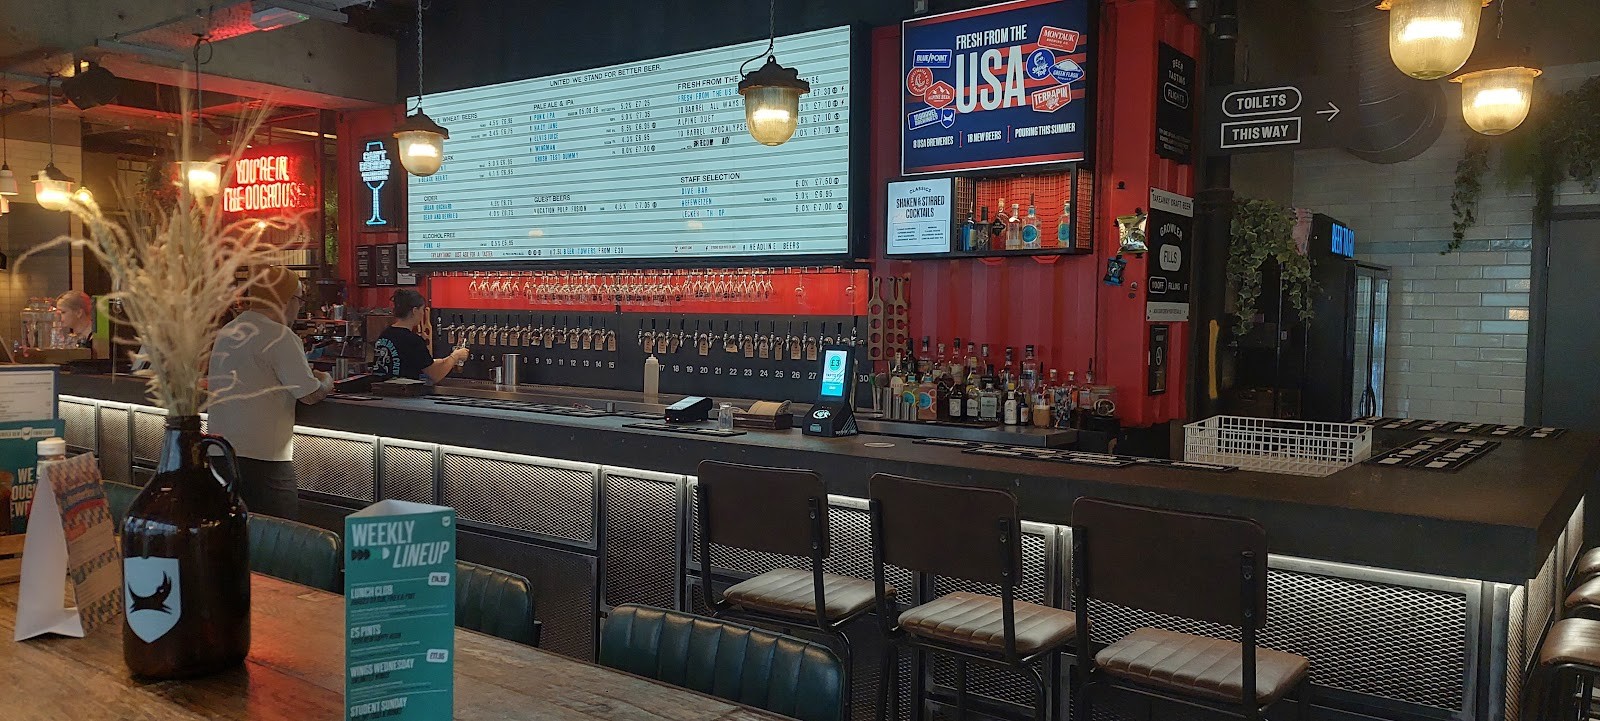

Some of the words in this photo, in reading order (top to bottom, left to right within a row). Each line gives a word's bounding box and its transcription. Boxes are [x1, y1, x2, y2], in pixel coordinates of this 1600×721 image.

[956, 32, 983, 50] FRESH
[984, 28, 1009, 44] FROM
[1010, 24, 1027, 40] THE
[584, 73, 602, 81] STAND
[618, 67, 642, 76] BETTER
[956, 46, 1026, 113] USA
[1168, 70, 1186, 86] TASTING
[677, 81, 700, 90] FRESH
[702, 78, 722, 86] FROM
[725, 76, 739, 84] THE
[678, 92, 692, 102] FRESH
[696, 90, 710, 99] FROM
[813, 88, 831, 96] £7.30
[1034, 87, 1068, 105] TERRAPIN
[1167, 89, 1185, 103] FLIGHTS
[685, 105, 704, 113] BARREL
[710, 102, 719, 110] ALL
[813, 101, 831, 109] £7.10
[1236, 94, 1287, 110] TOILETS
[677, 117, 697, 126] ALPINE
[813, 113, 831, 123] £7.10
[686, 128, 705, 136] BARREL
[711, 124, 746, 134] APOCALYPSE
[973, 133, 985, 142] NEW
[985, 131, 1001, 141] BEERS
[1015, 127, 1038, 138] POURING
[1038, 126, 1051, 135] THIS
[1051, 123, 1075, 134] SUMMER
[1232, 128, 1260, 141] THIS
[1261, 124, 1289, 139] WAY
[917, 139, 926, 148] USA
[927, 136, 954, 147] BREWERIES
[550, 153, 561, 161] TEST
[236, 156, 275, 184] YOU'RE
[276, 156, 289, 181] IN
[680, 174, 700, 183] STAFF
[702, 172, 740, 182] SELECTION
[681, 187, 694, 195] DIVE
[224, 187, 245, 212] THE
[681, 198, 712, 207] HEFEWEIZEN
[896, 197, 917, 208] SHAKEN
[922, 196, 944, 206] STIRRED
[1152, 193, 1169, 205] TAKEAWAY
[1171, 198, 1181, 208] DRAFT
[1182, 201, 1191, 210] BEER
[906, 208, 934, 218] COCKTAILS
[1159, 223, 1183, 241] GROWLER
[749, 242, 777, 250] HEADLINE
[783, 242, 800, 250] BEERS
[1163, 251, 1178, 264] FILLS
[686, 365, 693, 373] 19
[715, 367, 722, 375] 21
[729, 368, 737, 376] 22
[744, 369, 752, 377] 23
[775, 370, 783, 378] 25
[791, 371, 800, 379] 26
[808, 372, 817, 380] 27
[17, 468, 35, 483] WE
[351, 520, 415, 548] WEEKLY
[392, 541, 450, 569] LINEUP
[350, 587, 374, 599] LUNCH
[374, 585, 393, 596] CLUB
[361, 624, 381, 636] PINTS
[350, 664, 373, 677] WINGS
[374, 658, 415, 674] WEDNESDAY
[350, 702, 380, 717] STUDENT
[381, 697, 408, 711] SUNDAY
